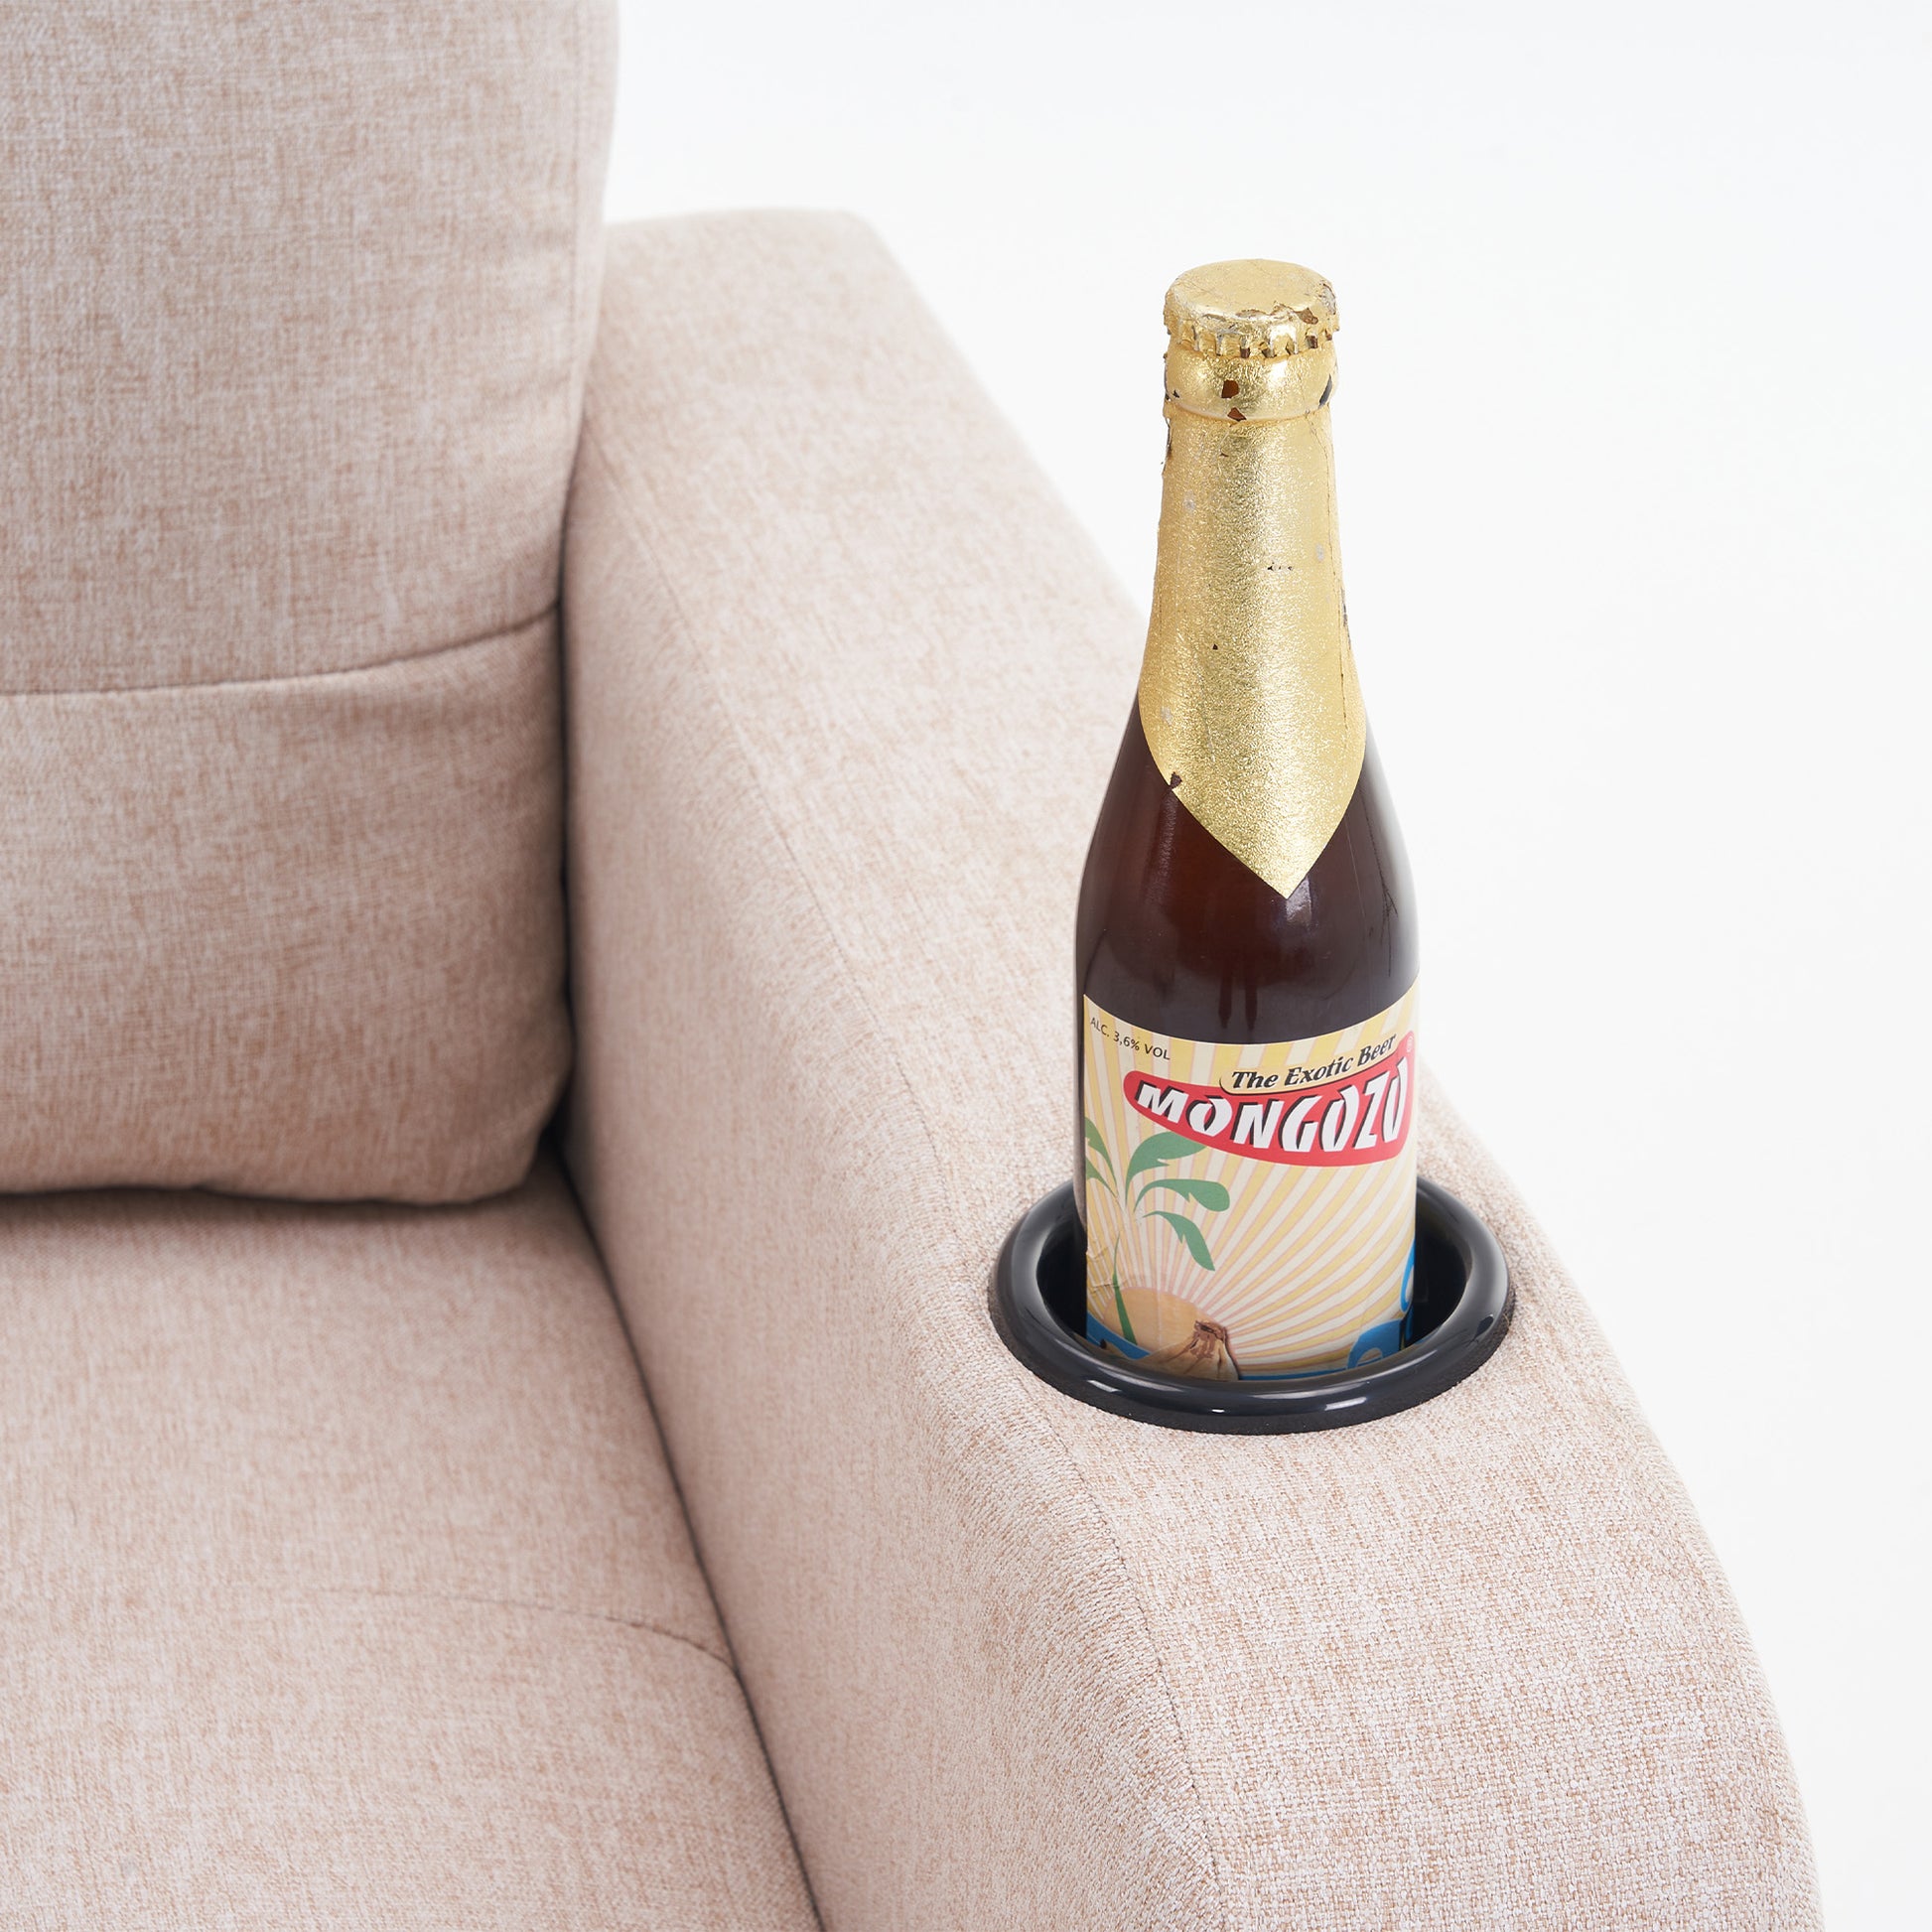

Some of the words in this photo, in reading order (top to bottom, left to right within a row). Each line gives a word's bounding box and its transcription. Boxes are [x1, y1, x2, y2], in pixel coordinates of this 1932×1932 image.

[1090, 1017, 1110, 1037] ALC.
[1113, 1031, 1140, 1051] 3,6%
[1144, 1043, 1171, 1060] VOL
[1232, 1071, 1279, 1089] The
[1285, 1056, 1354, 1086] Exotic
[1357, 1034, 1397, 1067] Beer
[1134, 1056, 1408, 1153] MONGOZO
